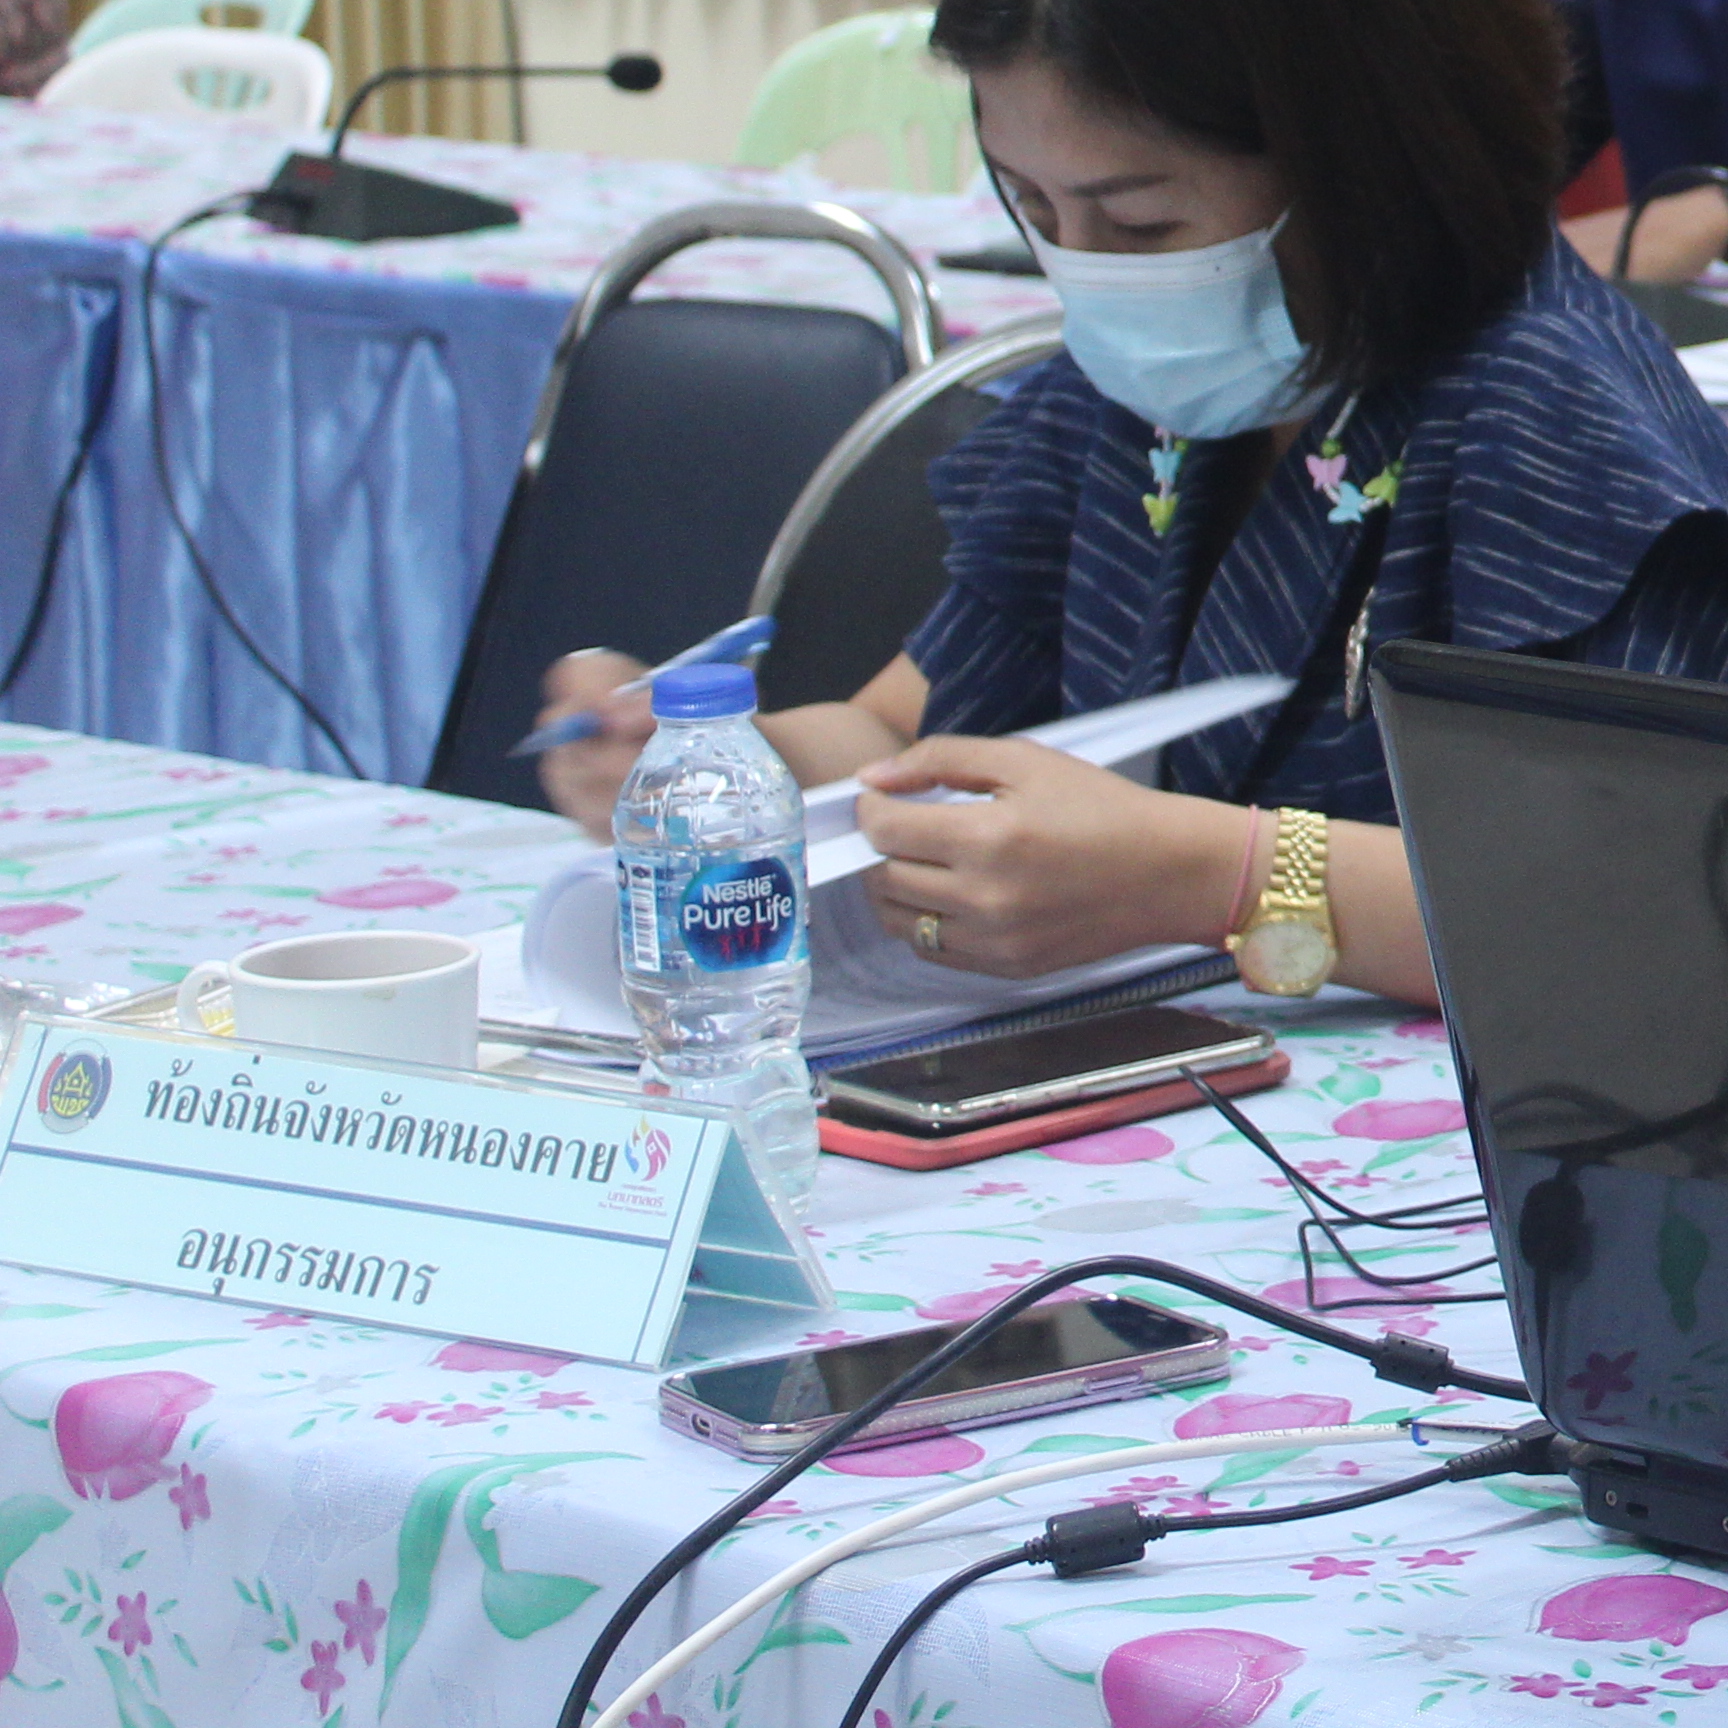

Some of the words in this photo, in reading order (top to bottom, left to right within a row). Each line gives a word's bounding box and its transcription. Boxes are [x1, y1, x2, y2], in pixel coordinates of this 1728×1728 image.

[683, 904, 751, 932] Pure
[754, 894, 793, 932] Life
[143, 1056, 619, 1185] ท้องถิ่นจังหวัดหนองคาย
[175, 1226, 440, 1306] อนุกรรมการ
